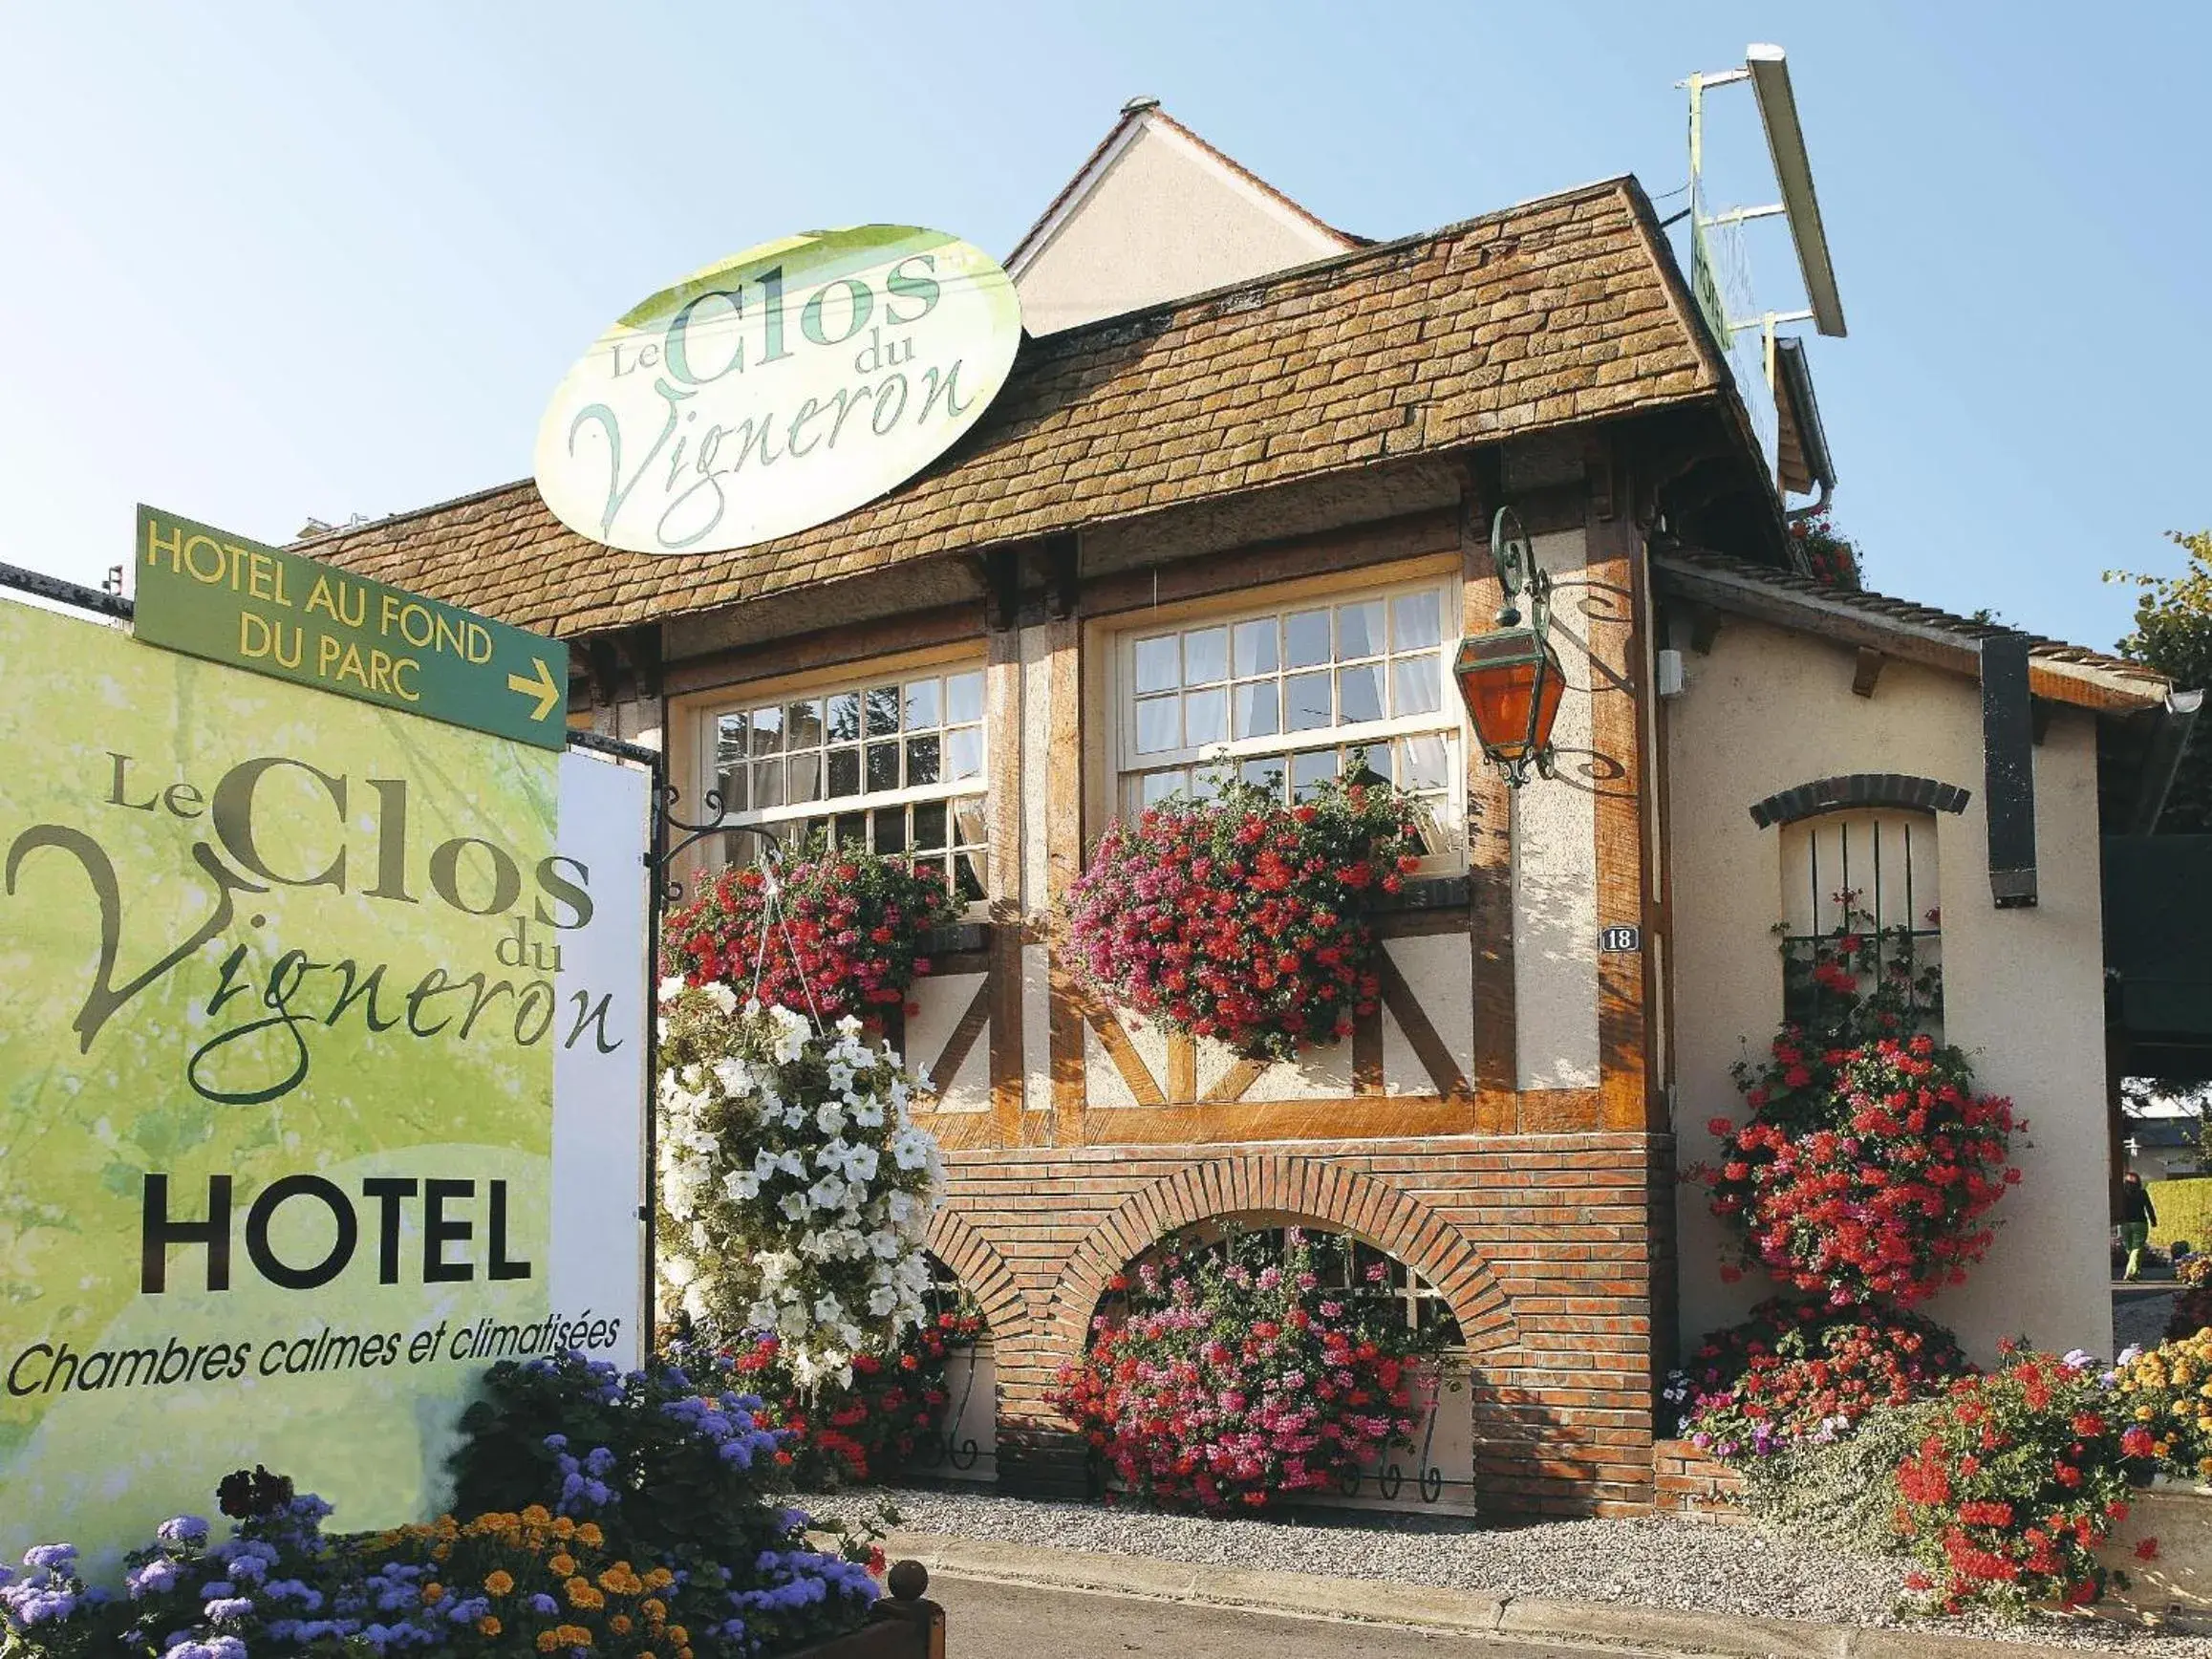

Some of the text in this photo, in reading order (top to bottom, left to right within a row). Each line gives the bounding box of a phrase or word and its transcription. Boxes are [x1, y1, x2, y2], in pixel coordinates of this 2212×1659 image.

[611, 255, 941, 385] Le Clos
[855, 326, 916, 375] du
[569, 359, 984, 549] Vigneron
[147, 520, 493, 665] HOTEL AU FOND
[240, 612, 421, 702] DU PARC
[105, 750, 594, 930] Le Clos
[5, 823, 624, 1105] Vigneron
[495, 916, 566, 973] du
[1609, 929, 1631, 949] 18
[141, 1173, 532, 1294] HOTEL
[8, 1309, 621, 1396] Chambres calmes et climatisées
